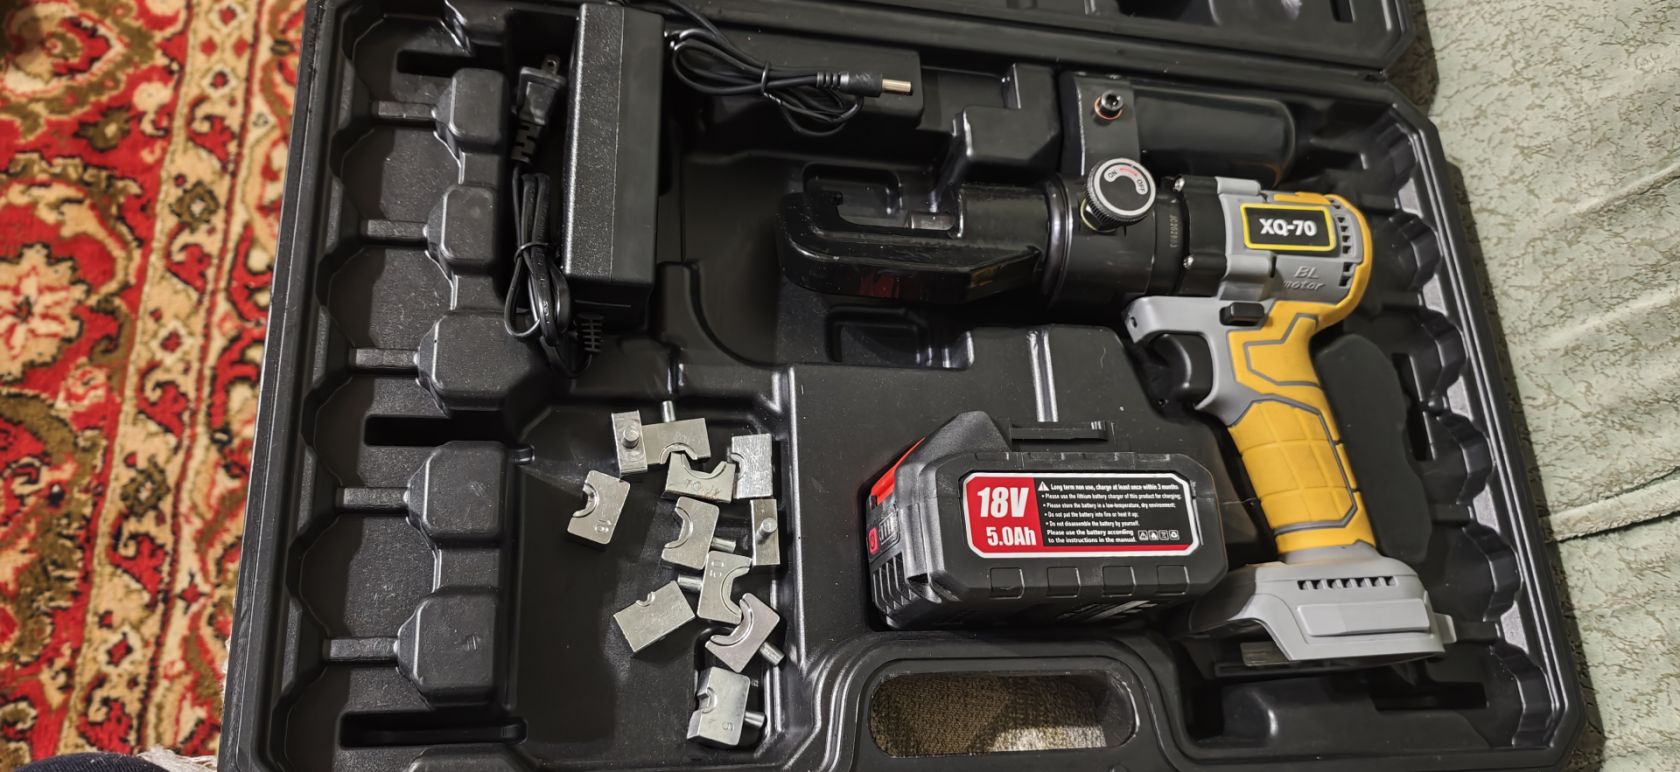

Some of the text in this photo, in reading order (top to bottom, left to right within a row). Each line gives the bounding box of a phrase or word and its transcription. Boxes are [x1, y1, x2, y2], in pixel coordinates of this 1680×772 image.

[1107, 170, 1117, 178] ON
[1137, 180, 1146, 192] OFF
[1259, 218, 1318, 237] XQ-70
[1294, 265, 1320, 280] BL
[977, 486, 1030, 519] 18V
[986, 526, 1037, 546] 5.0Ah
